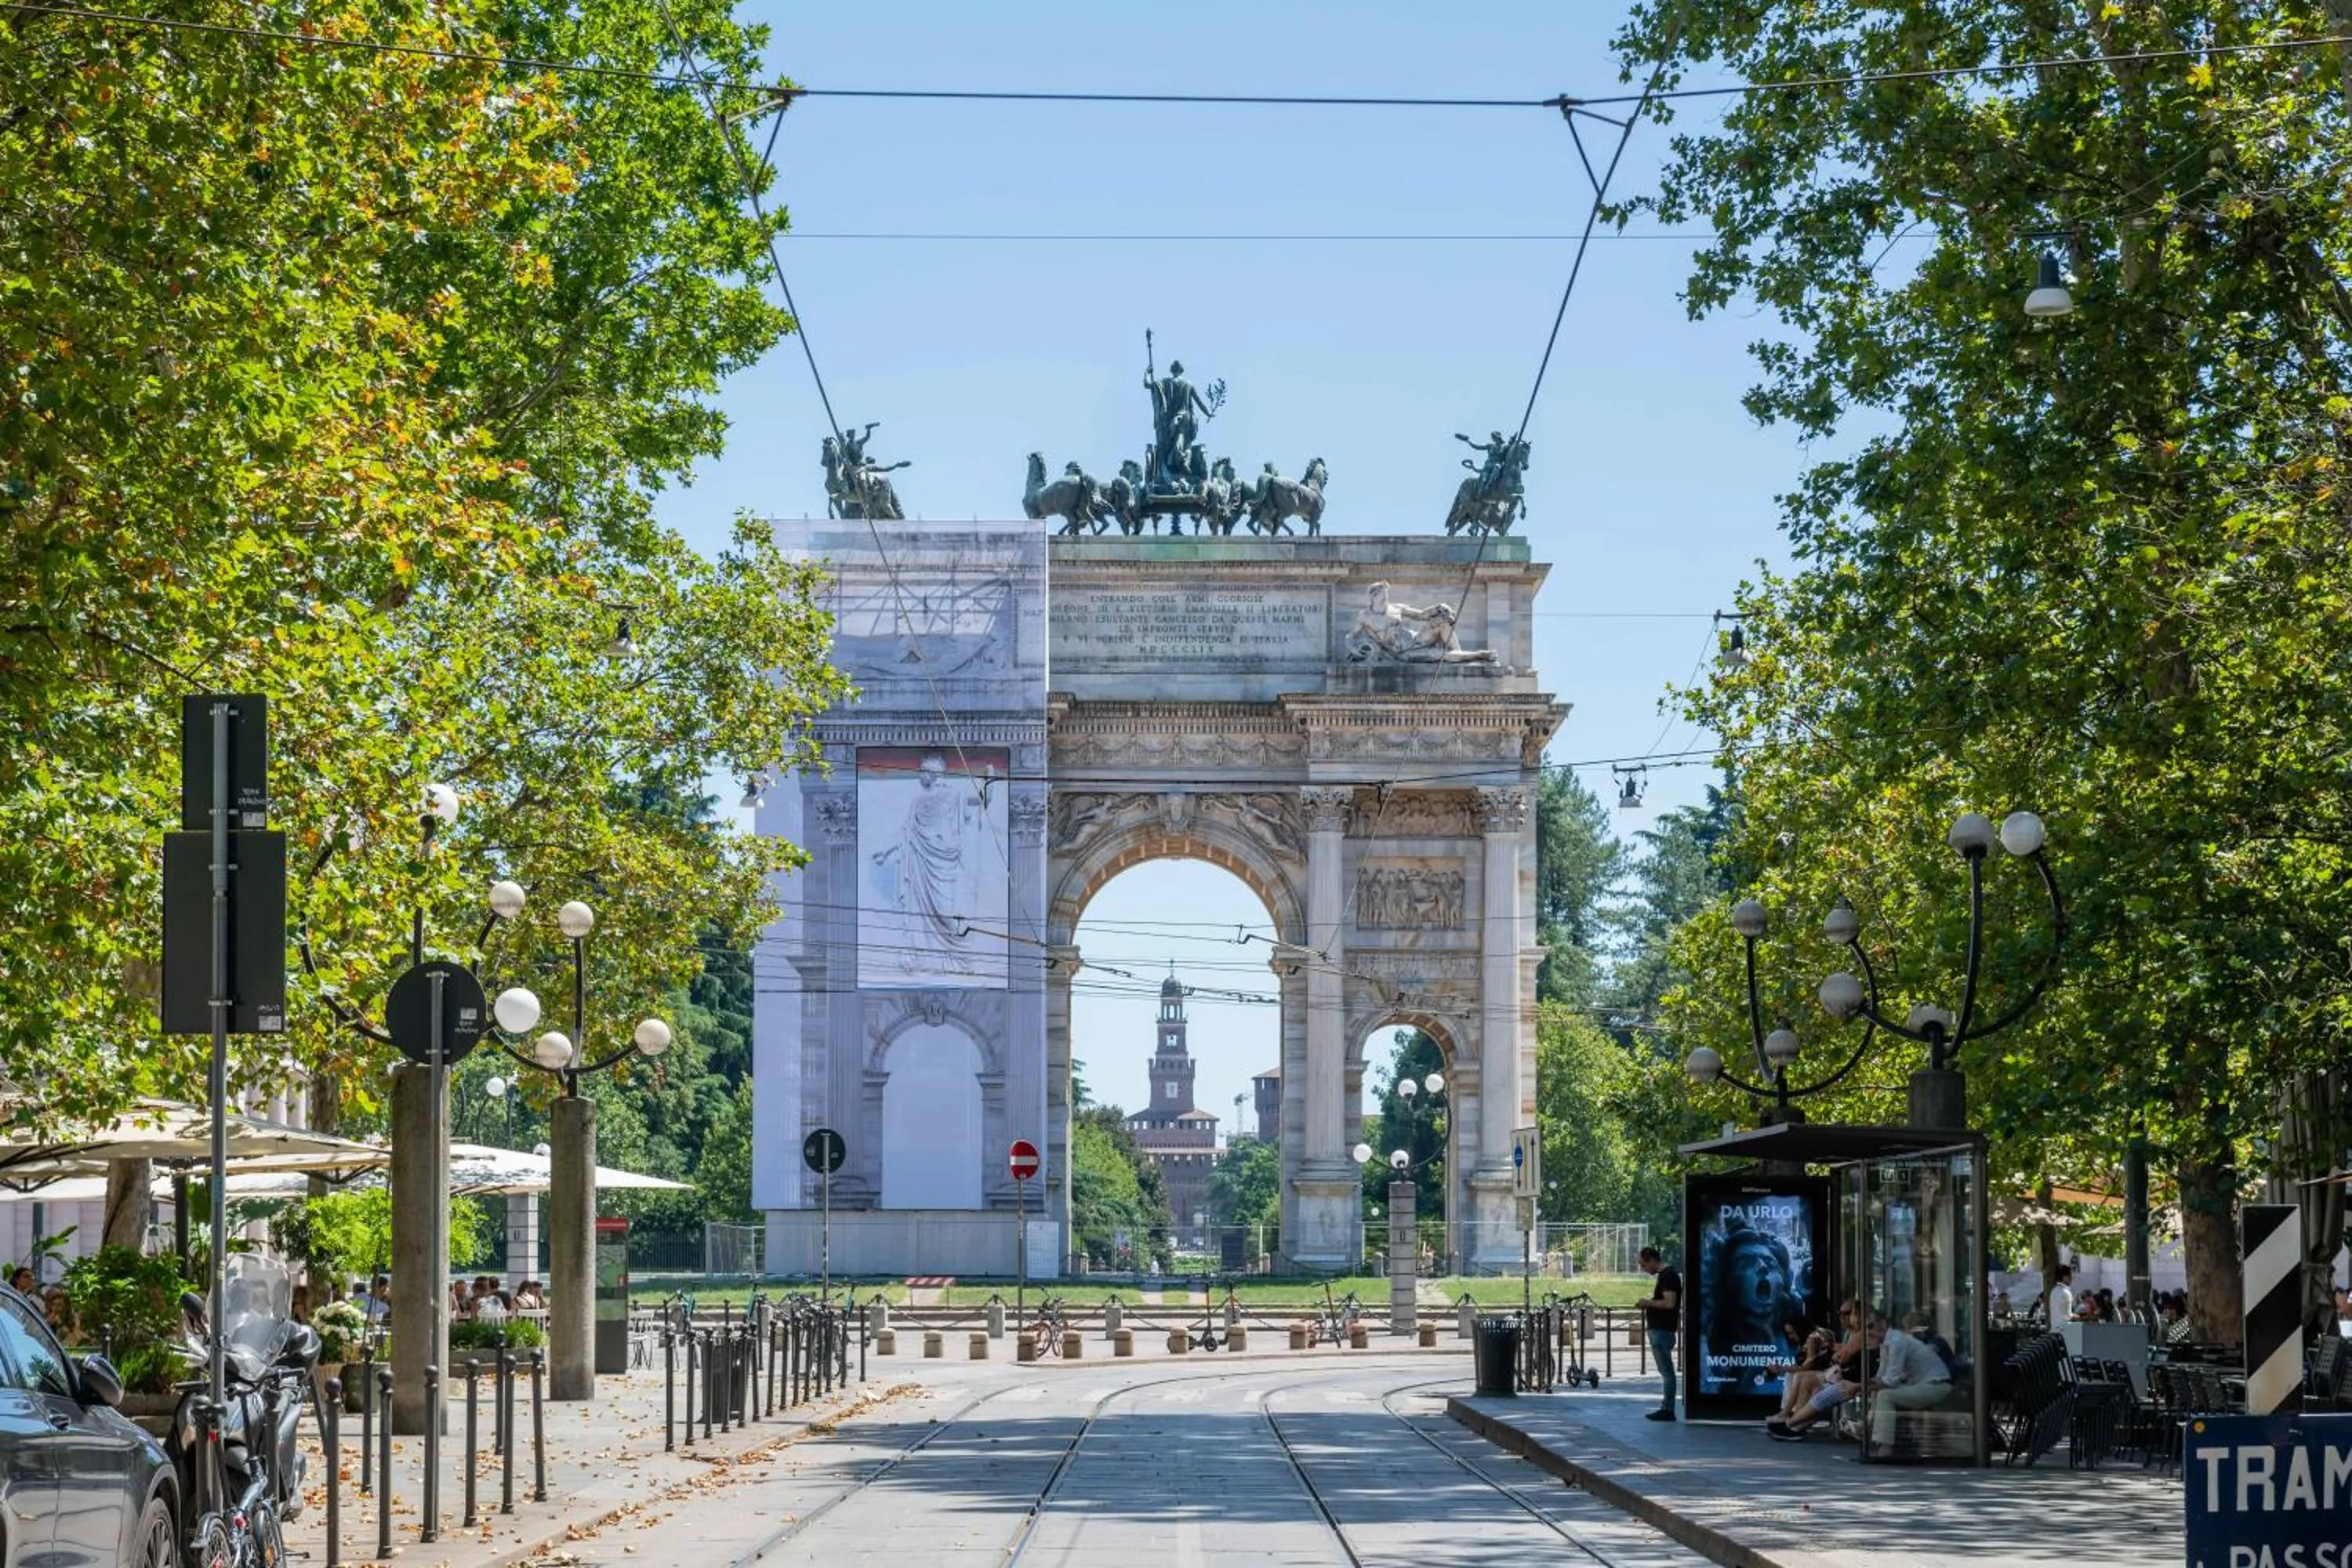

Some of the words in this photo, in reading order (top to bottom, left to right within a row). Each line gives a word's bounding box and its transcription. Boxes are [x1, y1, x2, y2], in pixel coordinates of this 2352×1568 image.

[1720, 1205, 1745, 1218] DA
[1748, 1205, 1793, 1218] URLO
[2196, 1445, 2352, 1512] TRAM
[2230, 1542, 2352, 1568] PASS
